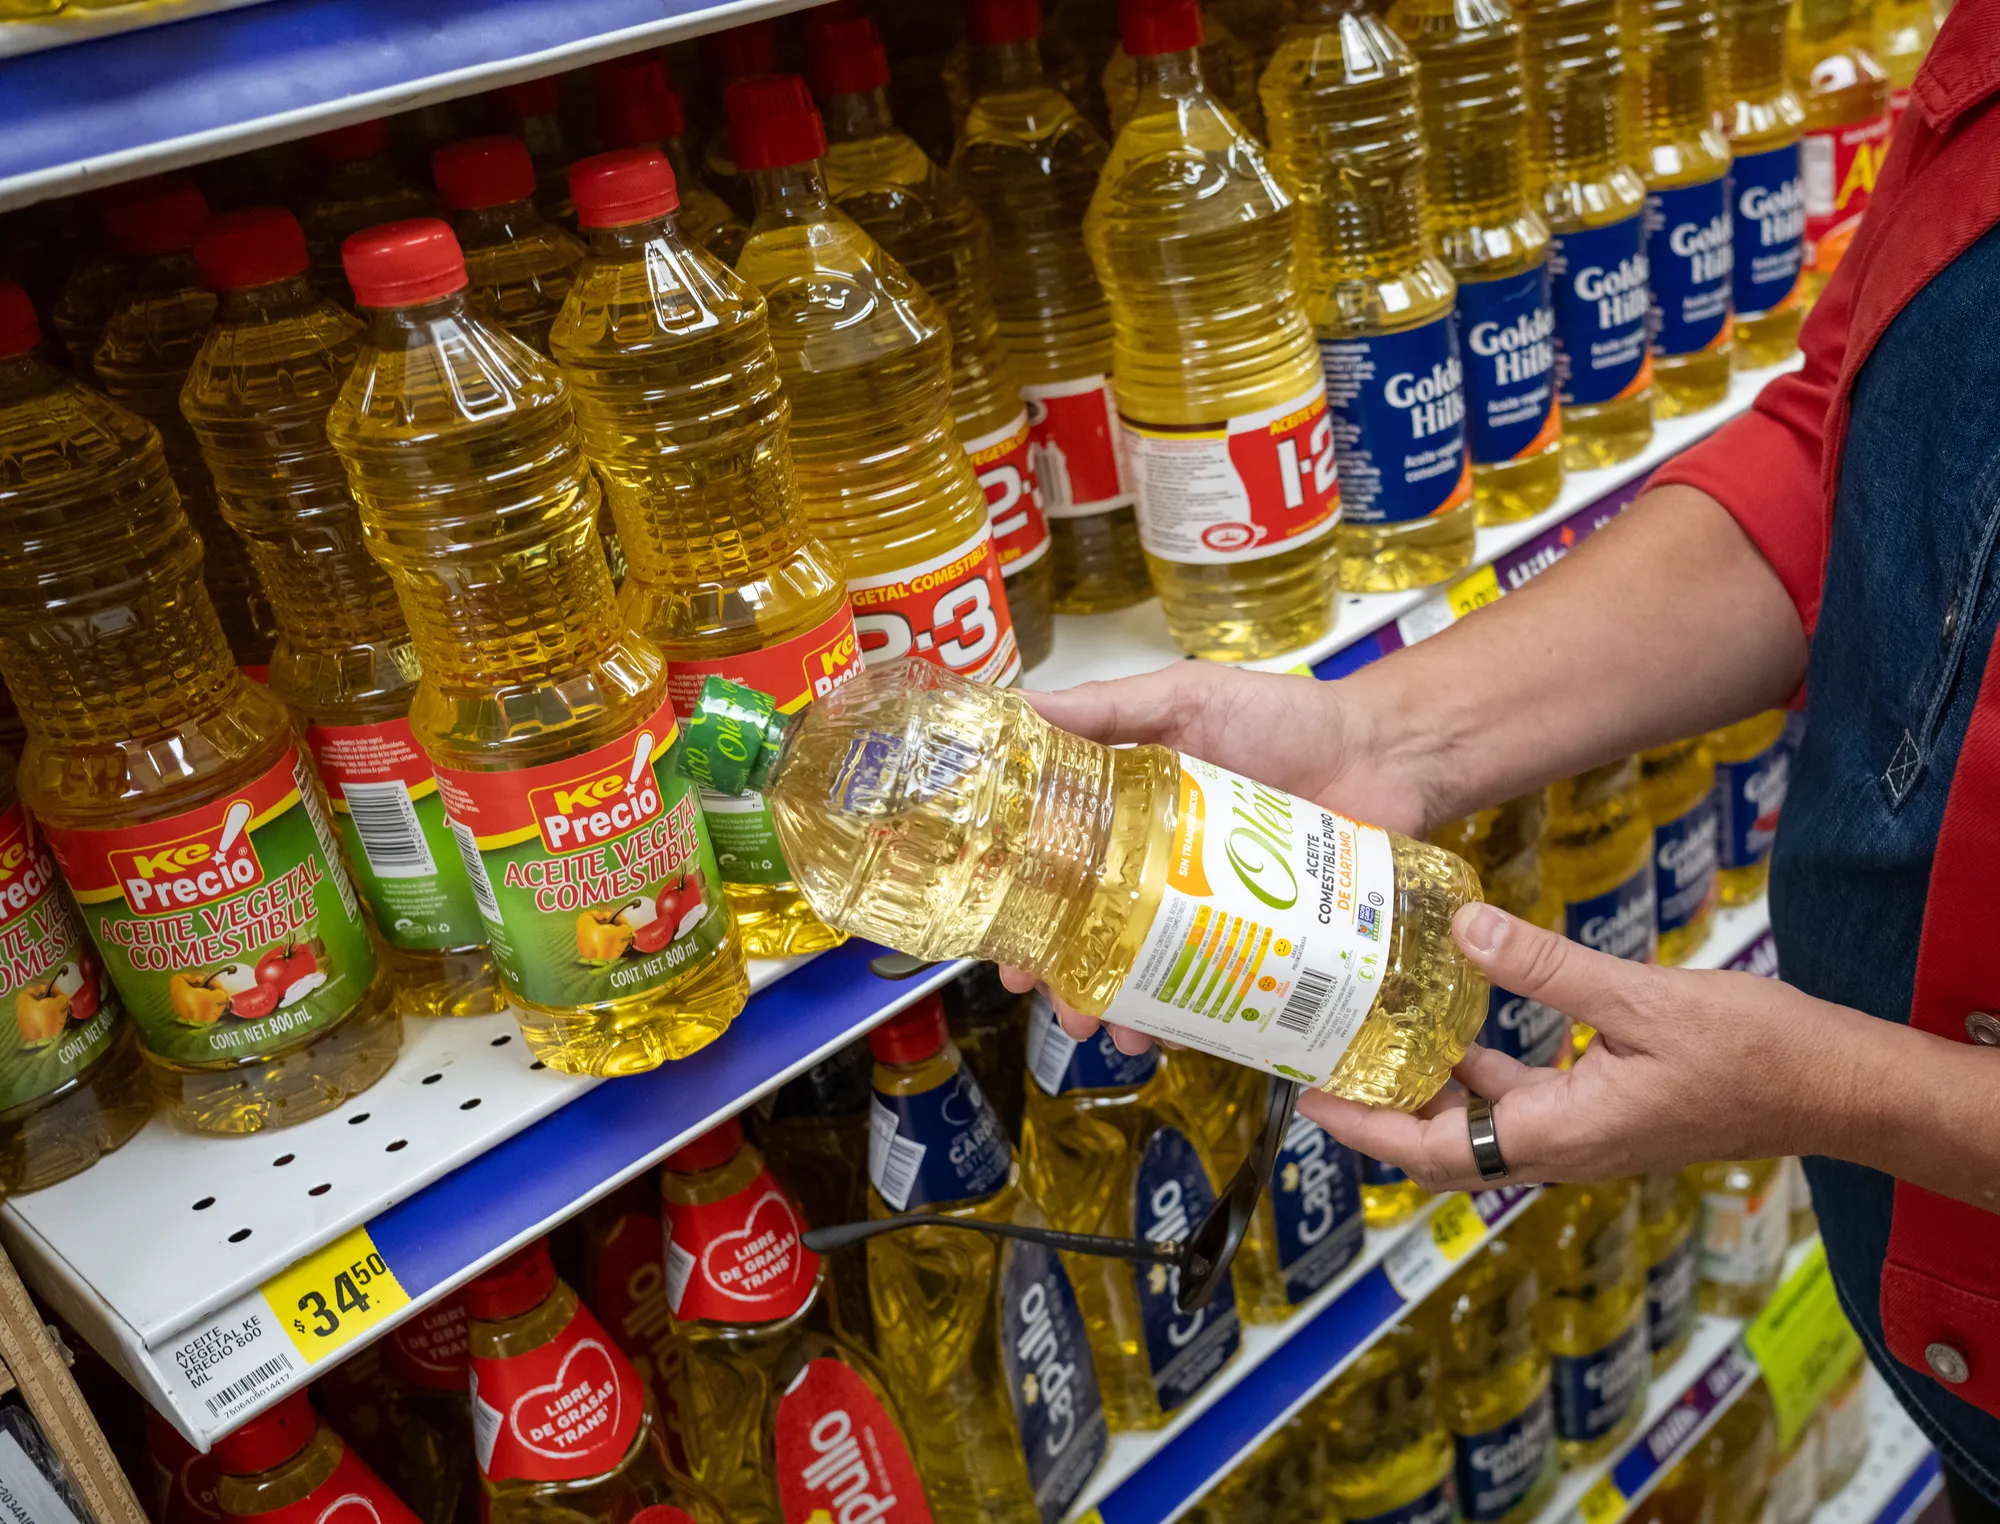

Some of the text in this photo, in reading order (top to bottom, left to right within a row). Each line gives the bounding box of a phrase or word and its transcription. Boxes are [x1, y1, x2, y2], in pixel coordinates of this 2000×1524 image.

[912, 541, 988, 595] COMESTIBLE
[505, 852, 605, 888] ACEITE
[618, 785, 700, 868] VEGETAL
[545, 792, 659, 849] Precio
[127, 855, 257, 910] Precio
[535, 823, 700, 914] COMESTIBLE
[1178, 857, 1188, 877] SIN
[1306, 833, 1320, 879] ACEITE
[1318, 813, 1336, 925] COMESTIBLE PURO
[1337, 831, 1352, 911] DE CÁRTAMO
[0, 852, 53, 920] recio
[99, 913, 194, 946] ACEITE
[201, 854, 324, 928] VEGETAL
[128, 888, 320, 971] COMESTIBLE
[610, 965, 641, 989] CONT.
[643, 956, 667, 979] NET.
[667, 947, 690, 971] 800
[58, 1035, 87, 1064] CONT.
[209, 1029, 244, 1051] CONT.
[244, 1022, 271, 1043] NET.
[271, 1015, 297, 1036] 800
[719, 1232, 796, 1285] DE GRASAS
[734, 1229, 776, 1263] LIBRE
[175, 1326, 223, 1362] ACEITE
[178, 1314, 261, 1370] VEGETAL KE
[184, 1327, 262, 1380] PRECIO 800
[190, 1373, 213, 1390] ML
[1017, 1282, 1076, 1457] Capullo
[529, 1381, 615, 1444] DE GRASAS
[544, 1380, 592, 1419] LIBRE
